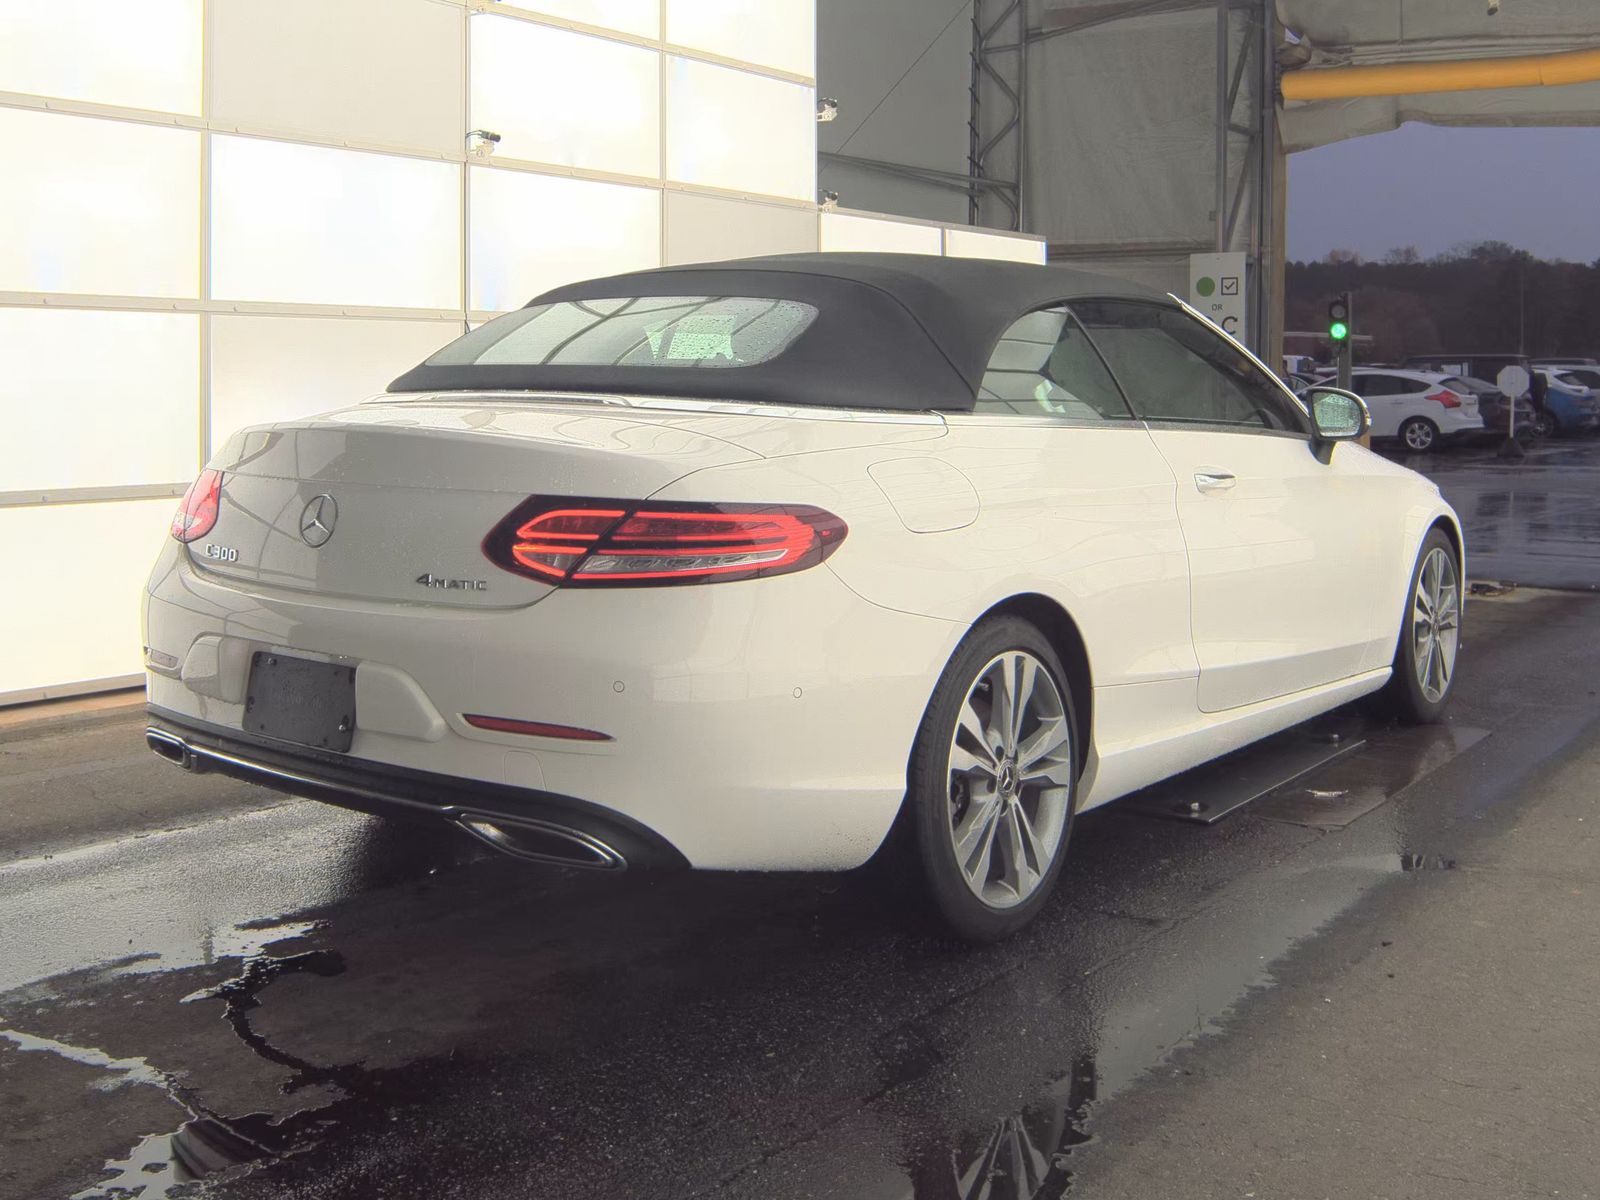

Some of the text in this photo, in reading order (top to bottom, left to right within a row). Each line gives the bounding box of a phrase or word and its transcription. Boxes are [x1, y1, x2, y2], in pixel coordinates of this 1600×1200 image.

[1211, 303, 1223, 311] OR
[205, 543, 239, 562] C300
[416, 573, 487, 591] 4MATIC
